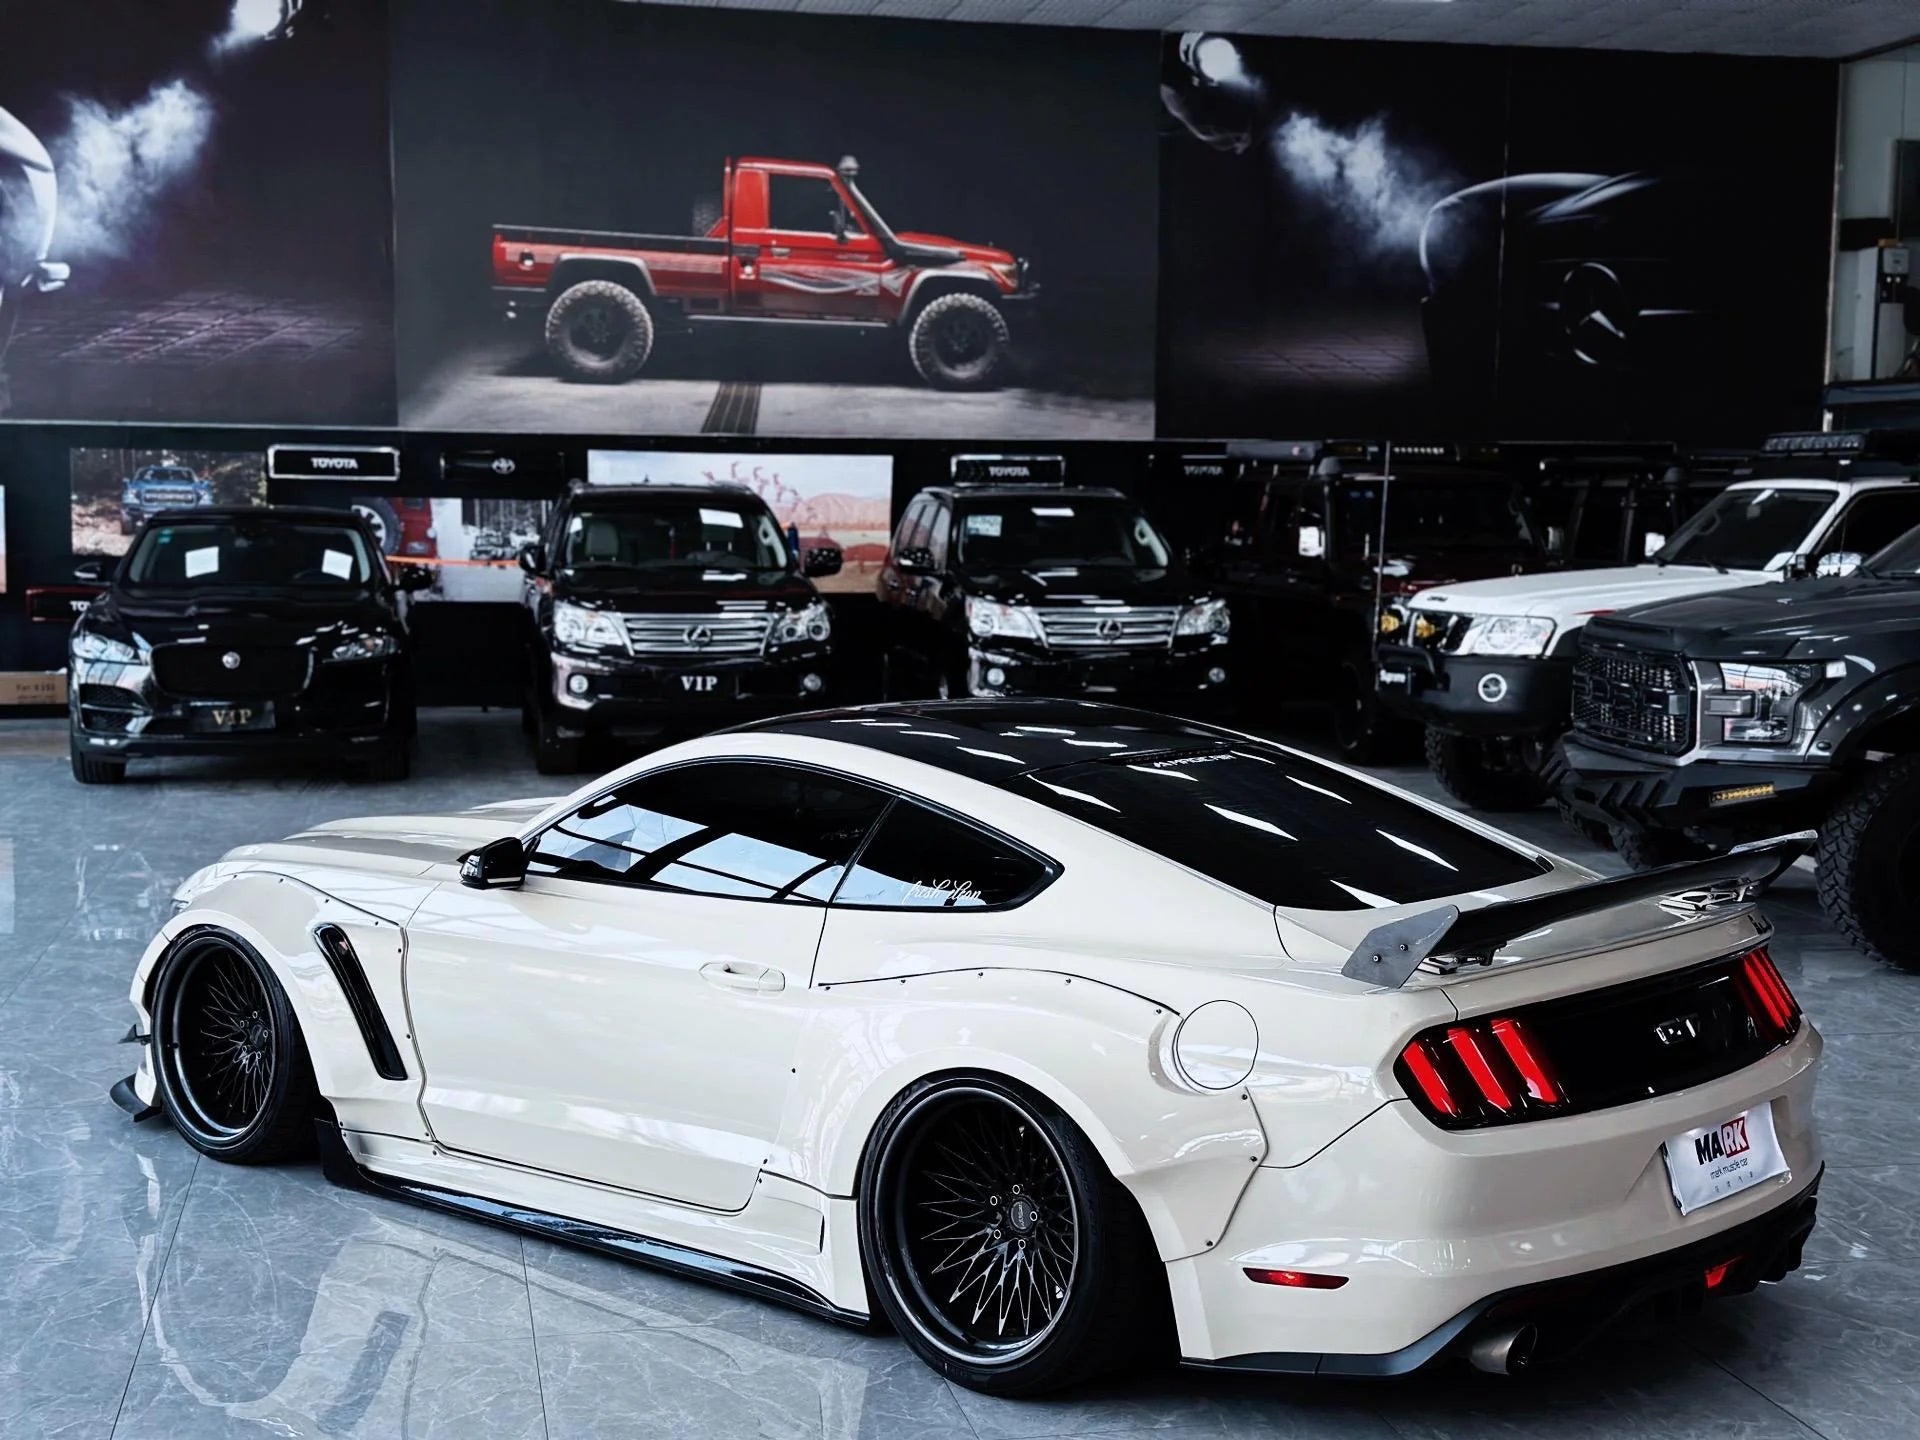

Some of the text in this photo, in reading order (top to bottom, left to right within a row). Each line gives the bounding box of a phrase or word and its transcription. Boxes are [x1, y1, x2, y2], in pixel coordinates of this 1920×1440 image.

[311, 457, 358, 469] TOYOTA
[988, 466, 1030, 477] TOYOTA
[681, 675, 718, 691] VIP
[212, 708, 252, 725] VIP
[1694, 1120, 1748, 1166] MARK
